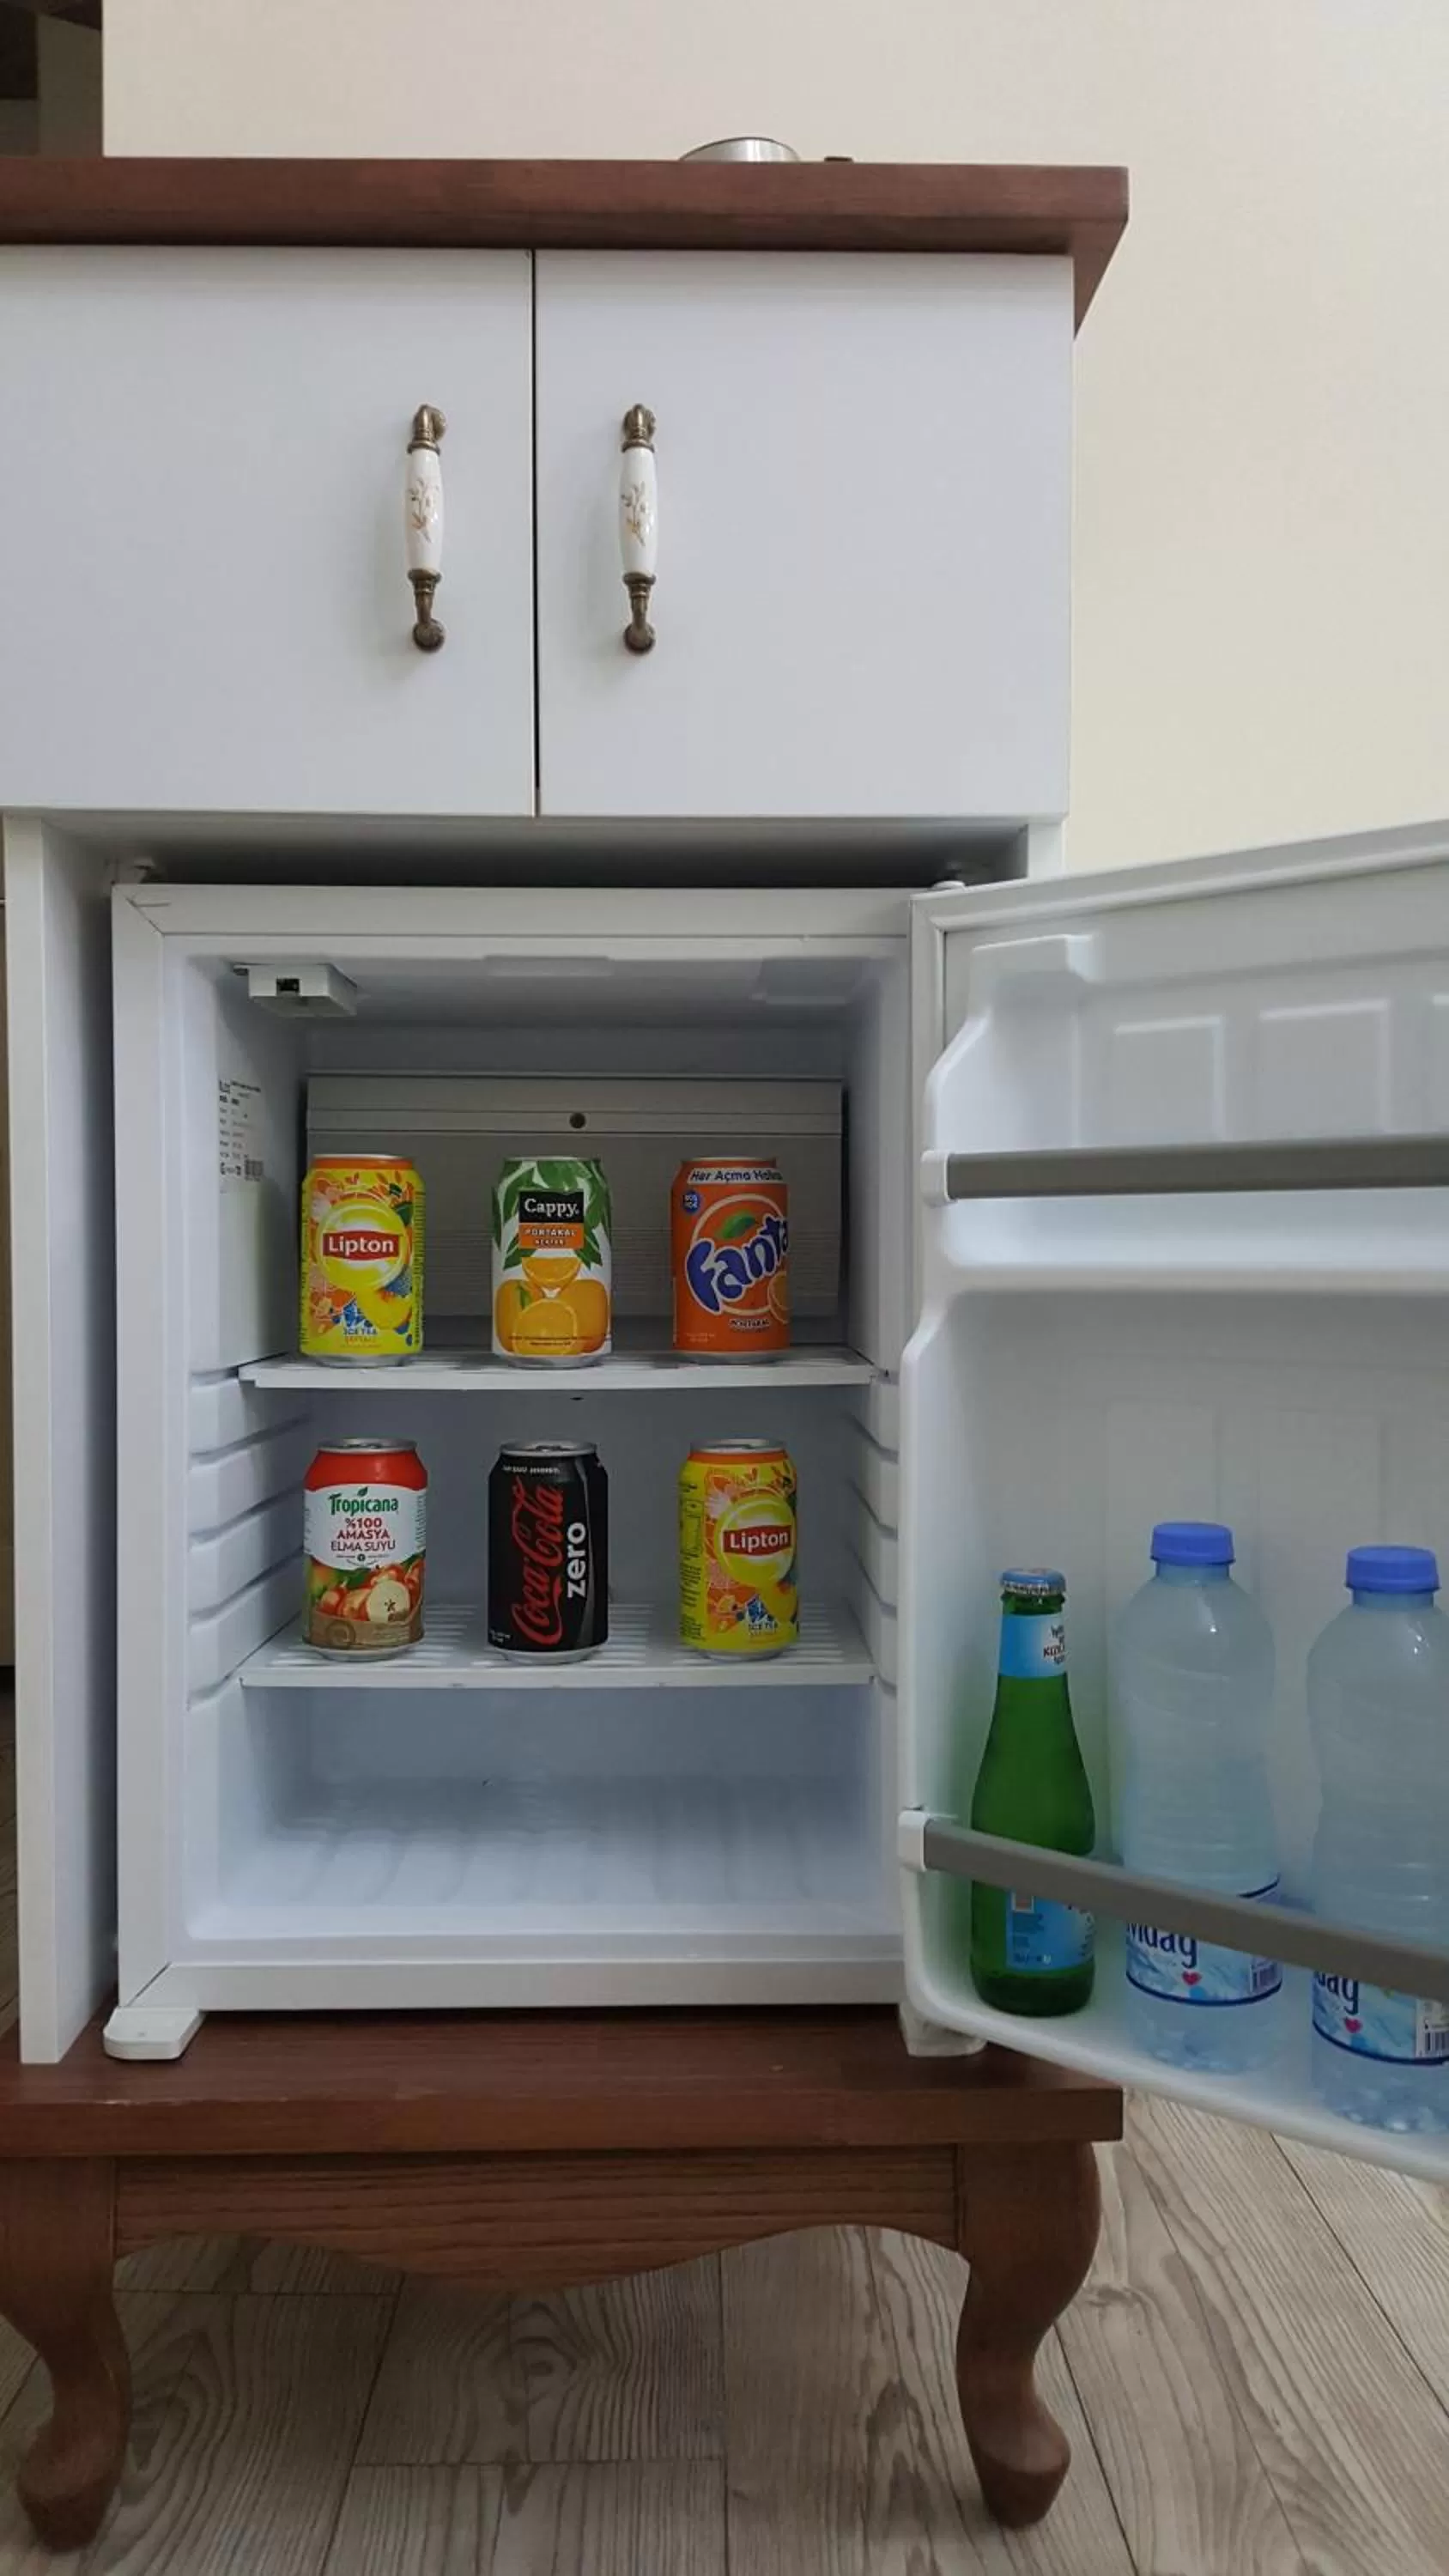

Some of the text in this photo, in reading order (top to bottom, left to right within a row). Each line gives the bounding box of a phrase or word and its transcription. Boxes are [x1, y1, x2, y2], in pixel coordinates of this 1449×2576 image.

[524, 1198, 578, 1218] Cappy
[328, 1236, 394, 1257] Lipton
[686, 1214, 788, 1314] Fanta
[328, 1492, 399, 1516] Tropicana
[345, 1517, 382, 1528] %100
[336, 1529, 390, 1540] AMASYA
[731, 1531, 788, 1553] Lipton
[330, 1540, 396, 1552] ELMA SUYU
[567, 1522, 586, 1599] zero
